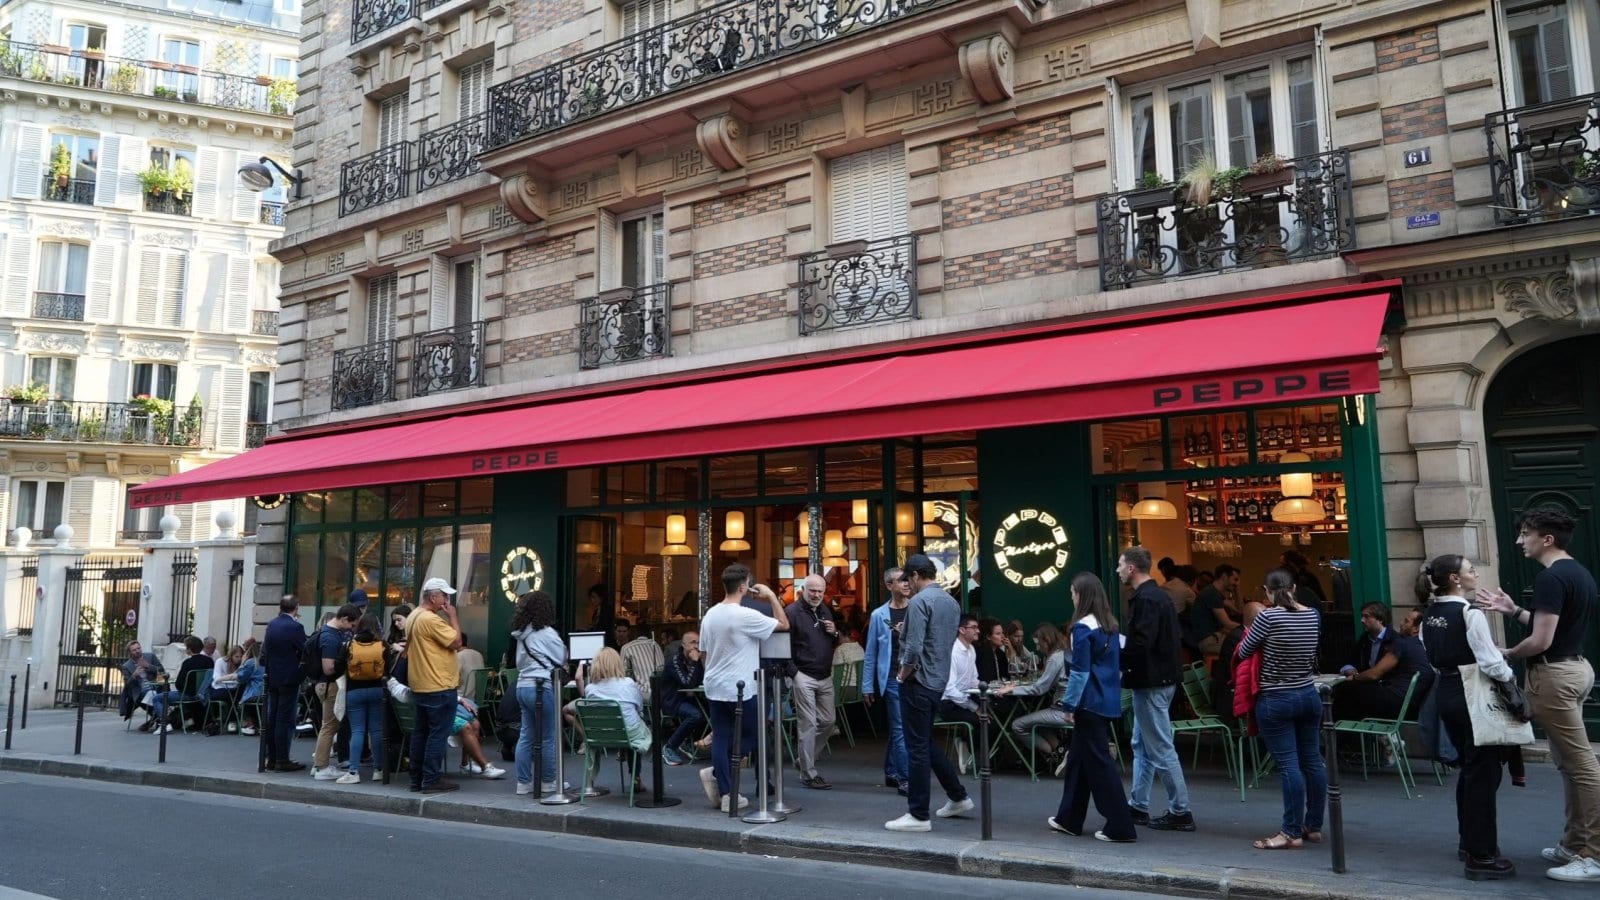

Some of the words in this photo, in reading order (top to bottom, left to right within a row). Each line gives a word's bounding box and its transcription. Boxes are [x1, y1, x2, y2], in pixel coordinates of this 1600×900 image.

[1408, 150, 1427, 164] 61
[1414, 214, 1431, 223] GAZ
[1153, 370, 1350, 407] PEPPE
[473, 451, 558, 470] PEPPE
[994, 509, 1068, 547] PEPPE
